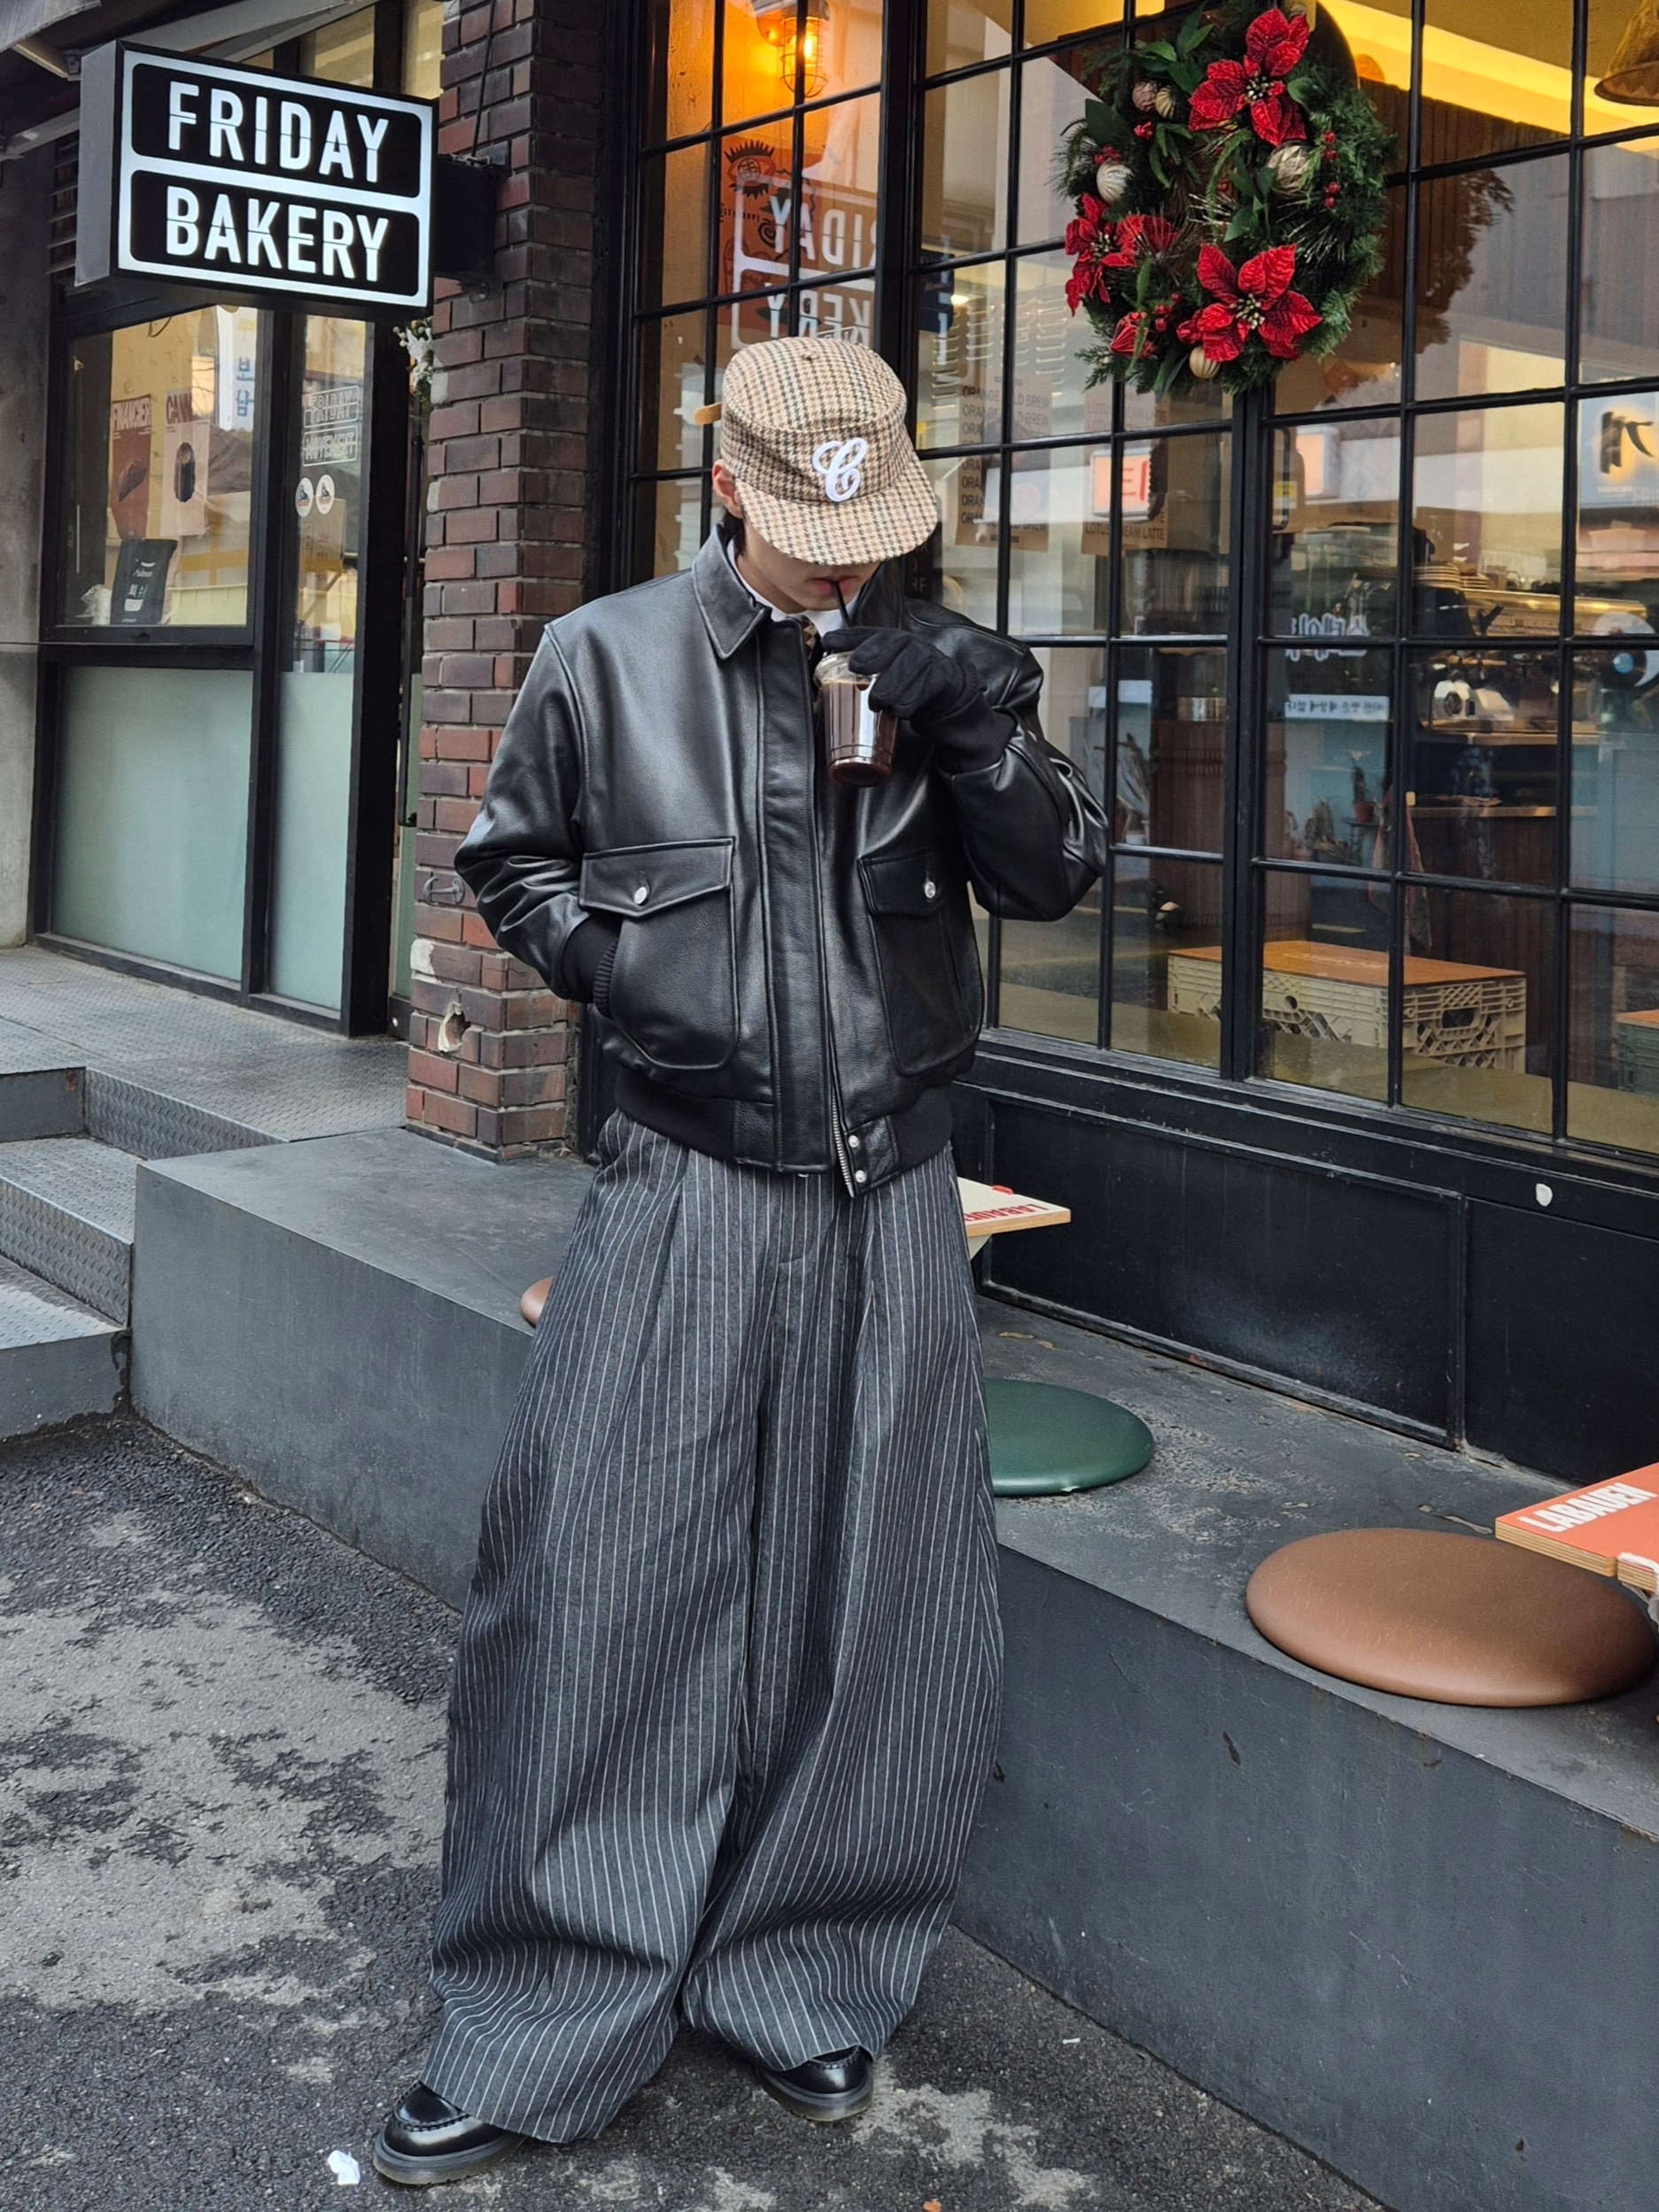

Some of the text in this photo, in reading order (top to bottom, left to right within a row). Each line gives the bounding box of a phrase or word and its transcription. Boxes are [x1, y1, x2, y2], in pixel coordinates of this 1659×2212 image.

[167, 81, 388, 182] FRIDAY
[167, 185, 388, 282] BAKERY
[310, 391, 353, 423] FRIDAY
[1088, 402, 1109, 414] LOTU
[306, 432, 354, 460] MOVEMENT
[1143, 528, 1166, 540] LATTE
